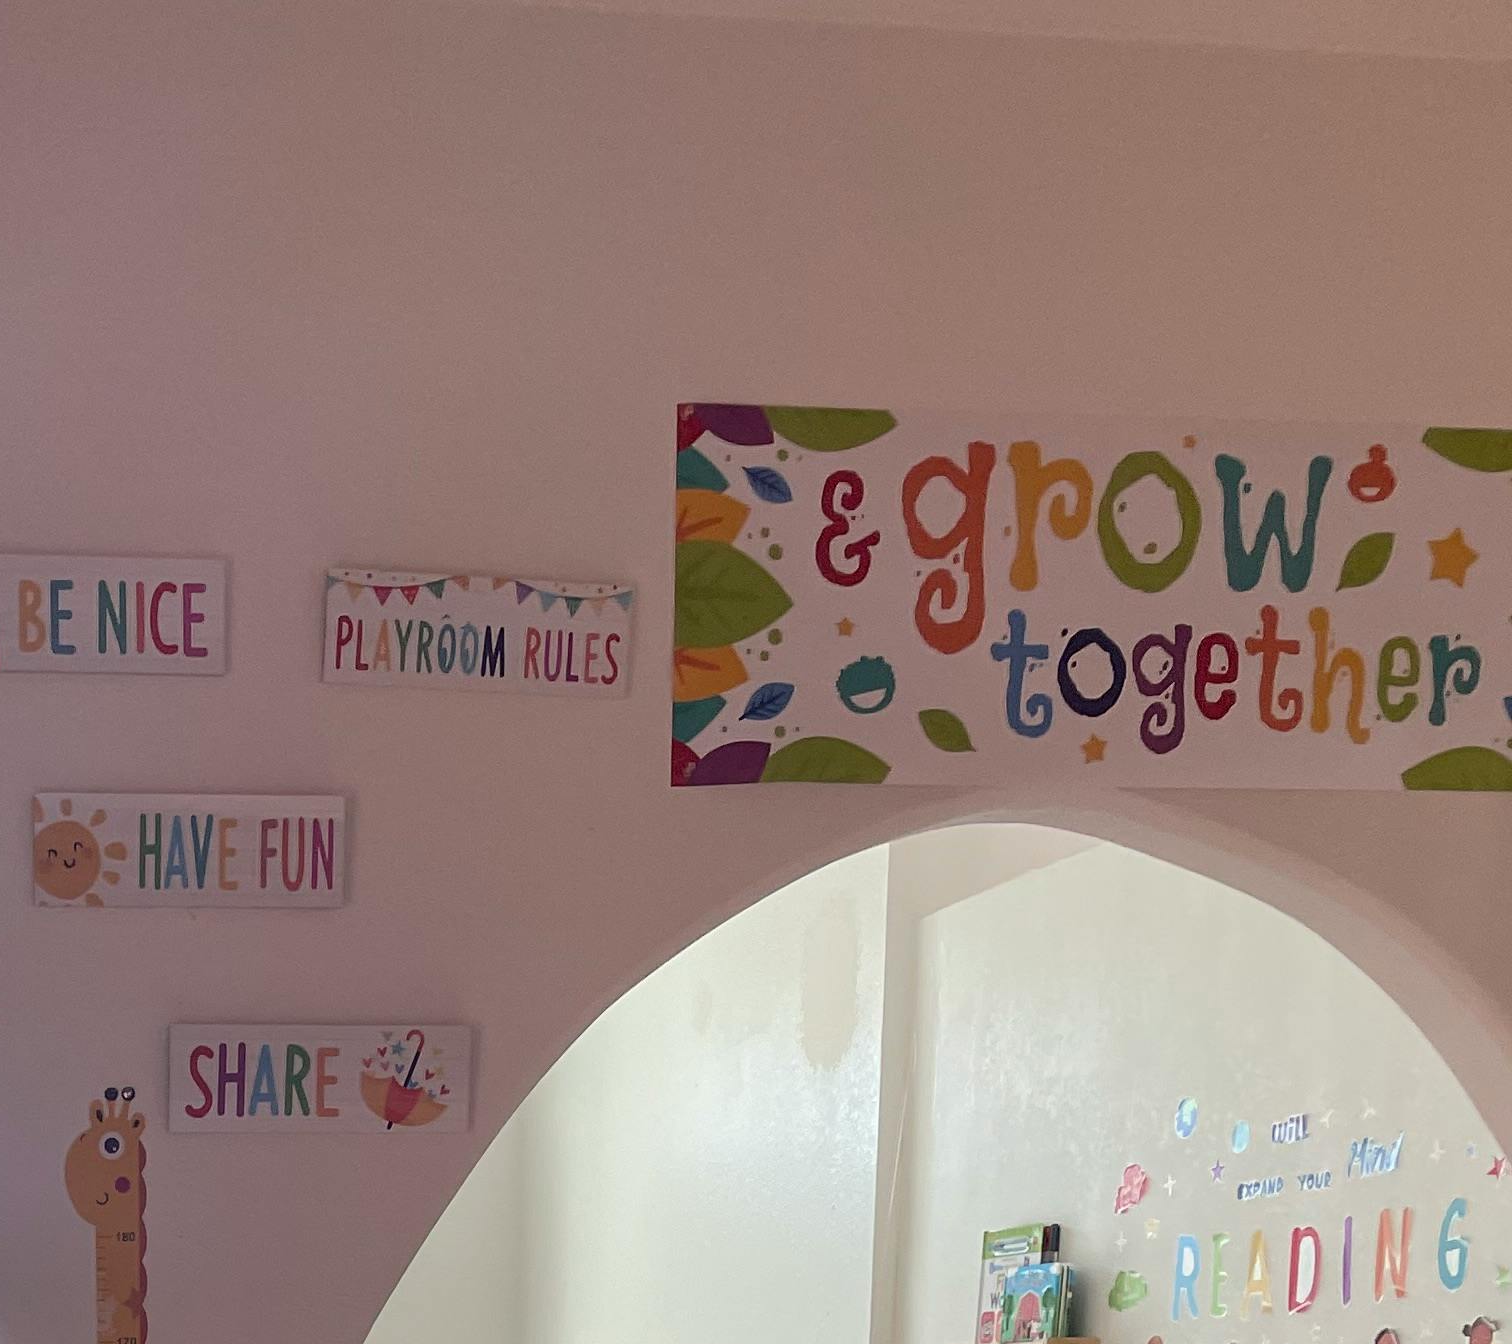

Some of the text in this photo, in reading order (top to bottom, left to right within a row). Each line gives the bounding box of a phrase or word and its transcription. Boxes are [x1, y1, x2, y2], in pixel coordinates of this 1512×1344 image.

[815, 441, 1333, 654] & grow
[19, 579, 208, 657] BE NICE
[336, 614, 621, 685] PLAYROOM RULES
[991, 604, 1481, 754] together
[139, 813, 334, 892] HAVE FUN
[185, 1042, 339, 1118] SHARE
[117, 1231, 136, 1244] 180
[1171, 1198, 1470, 1321] READING
